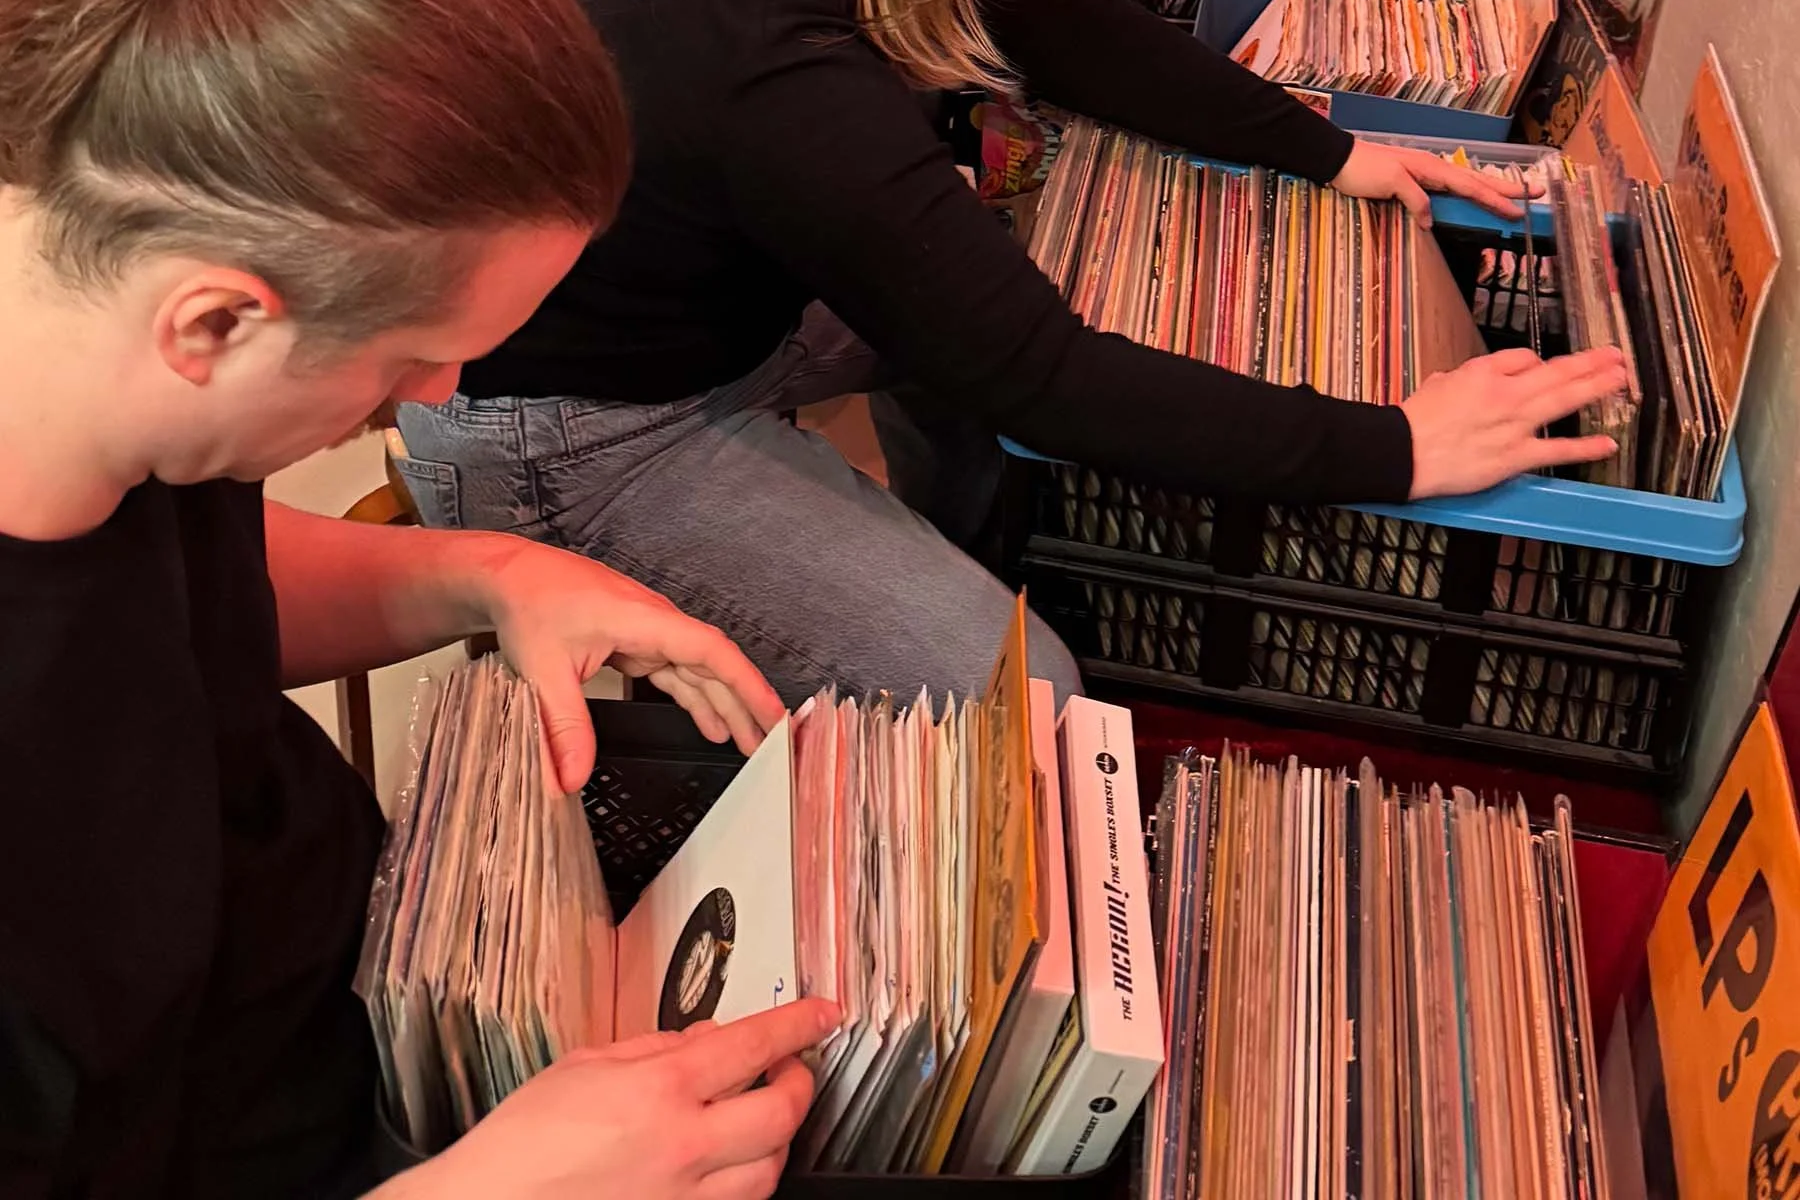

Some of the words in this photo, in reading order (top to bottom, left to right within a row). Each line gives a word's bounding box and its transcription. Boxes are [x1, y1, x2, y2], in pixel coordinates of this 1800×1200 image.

[1104, 777, 1115, 816] BOXSET
[1107, 817, 1119, 861] SINGLES
[1110, 863, 1120, 884] THE
[1122, 996, 1133, 1021] THE
